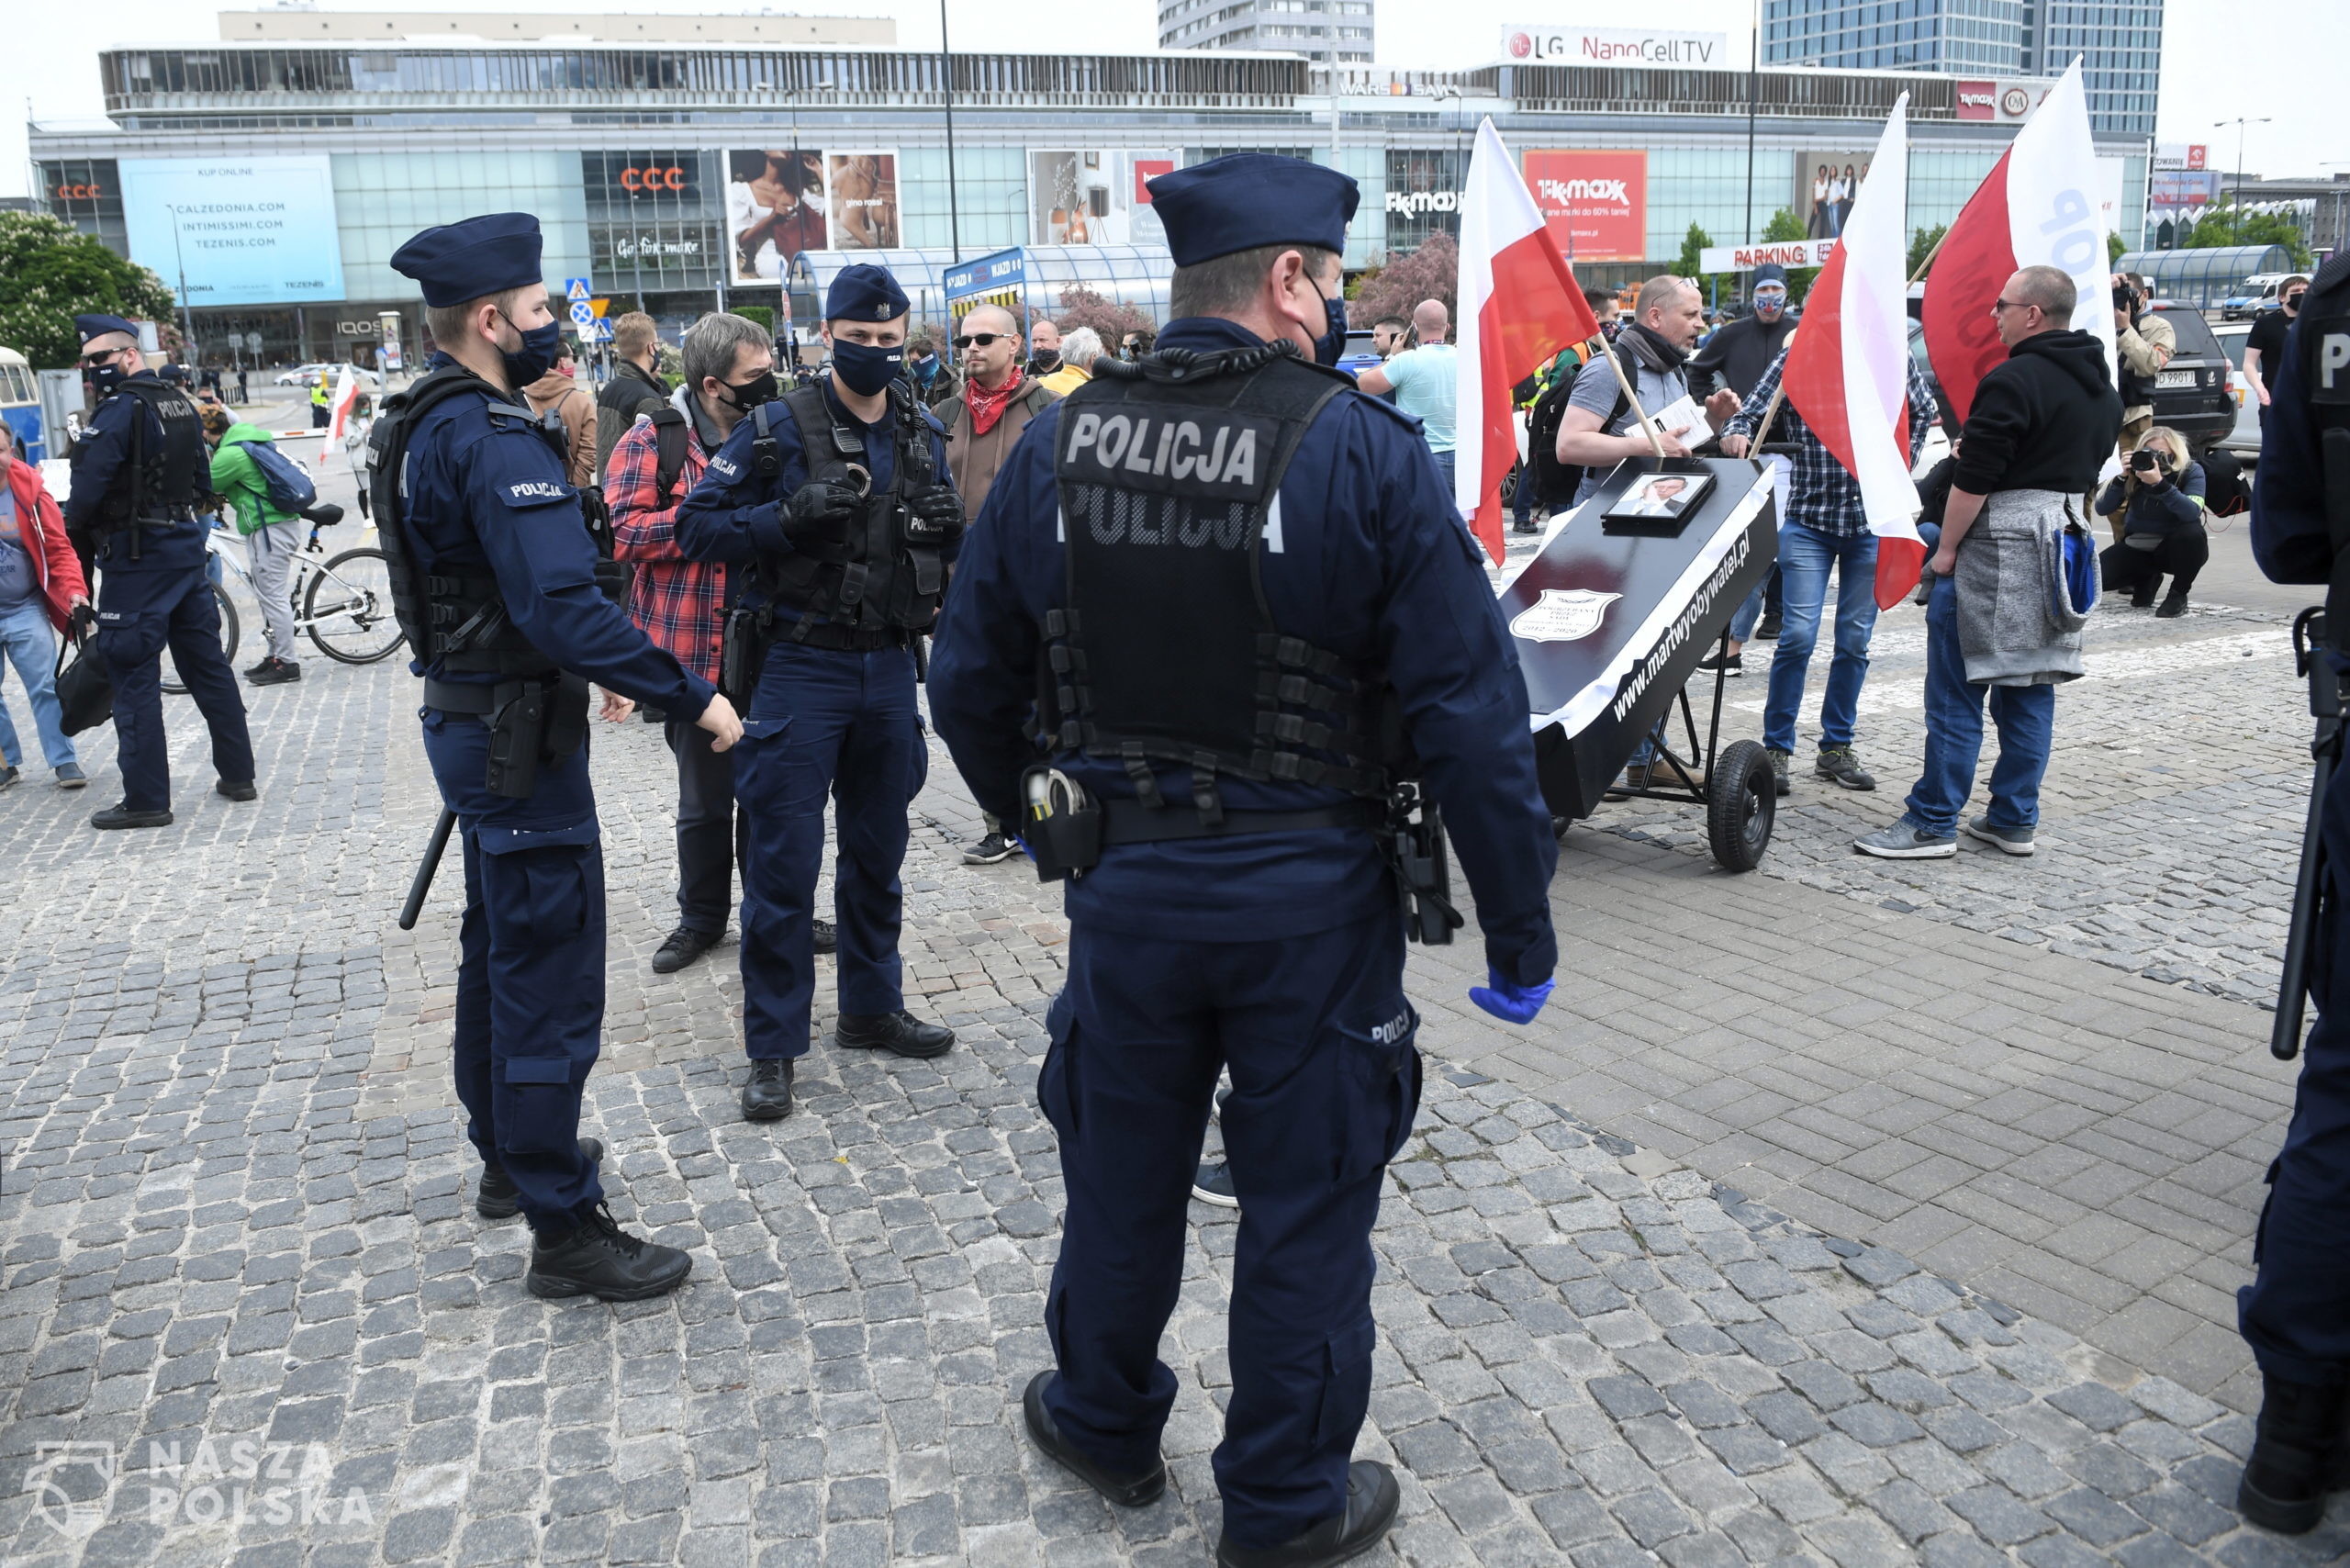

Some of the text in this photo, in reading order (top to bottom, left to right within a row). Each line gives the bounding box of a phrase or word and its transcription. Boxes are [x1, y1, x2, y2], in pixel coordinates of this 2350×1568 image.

[1338, 83, 1391, 96] WARS
[197, 167, 253, 177] KUP ONLINE
[620, 167, 686, 191] CCC
[58, 184, 103, 198] CCC
[176, 202, 285, 215] CALZEDONIA.COM
[845, 197, 883, 208] gino rossi
[183, 219, 284, 231] INTIMISSIMI.COM
[196, 238, 276, 249] TEZENIS.COM
[1734, 245, 1805, 267] PARKING
[285, 280, 324, 289] TEZENIS
[336, 321, 382, 336] IQOS
[1066, 413, 1257, 485] POLICJA
[509, 482, 566, 498] POLICJA
[1613, 529, 1751, 723] www.martwyobywatel.pl
